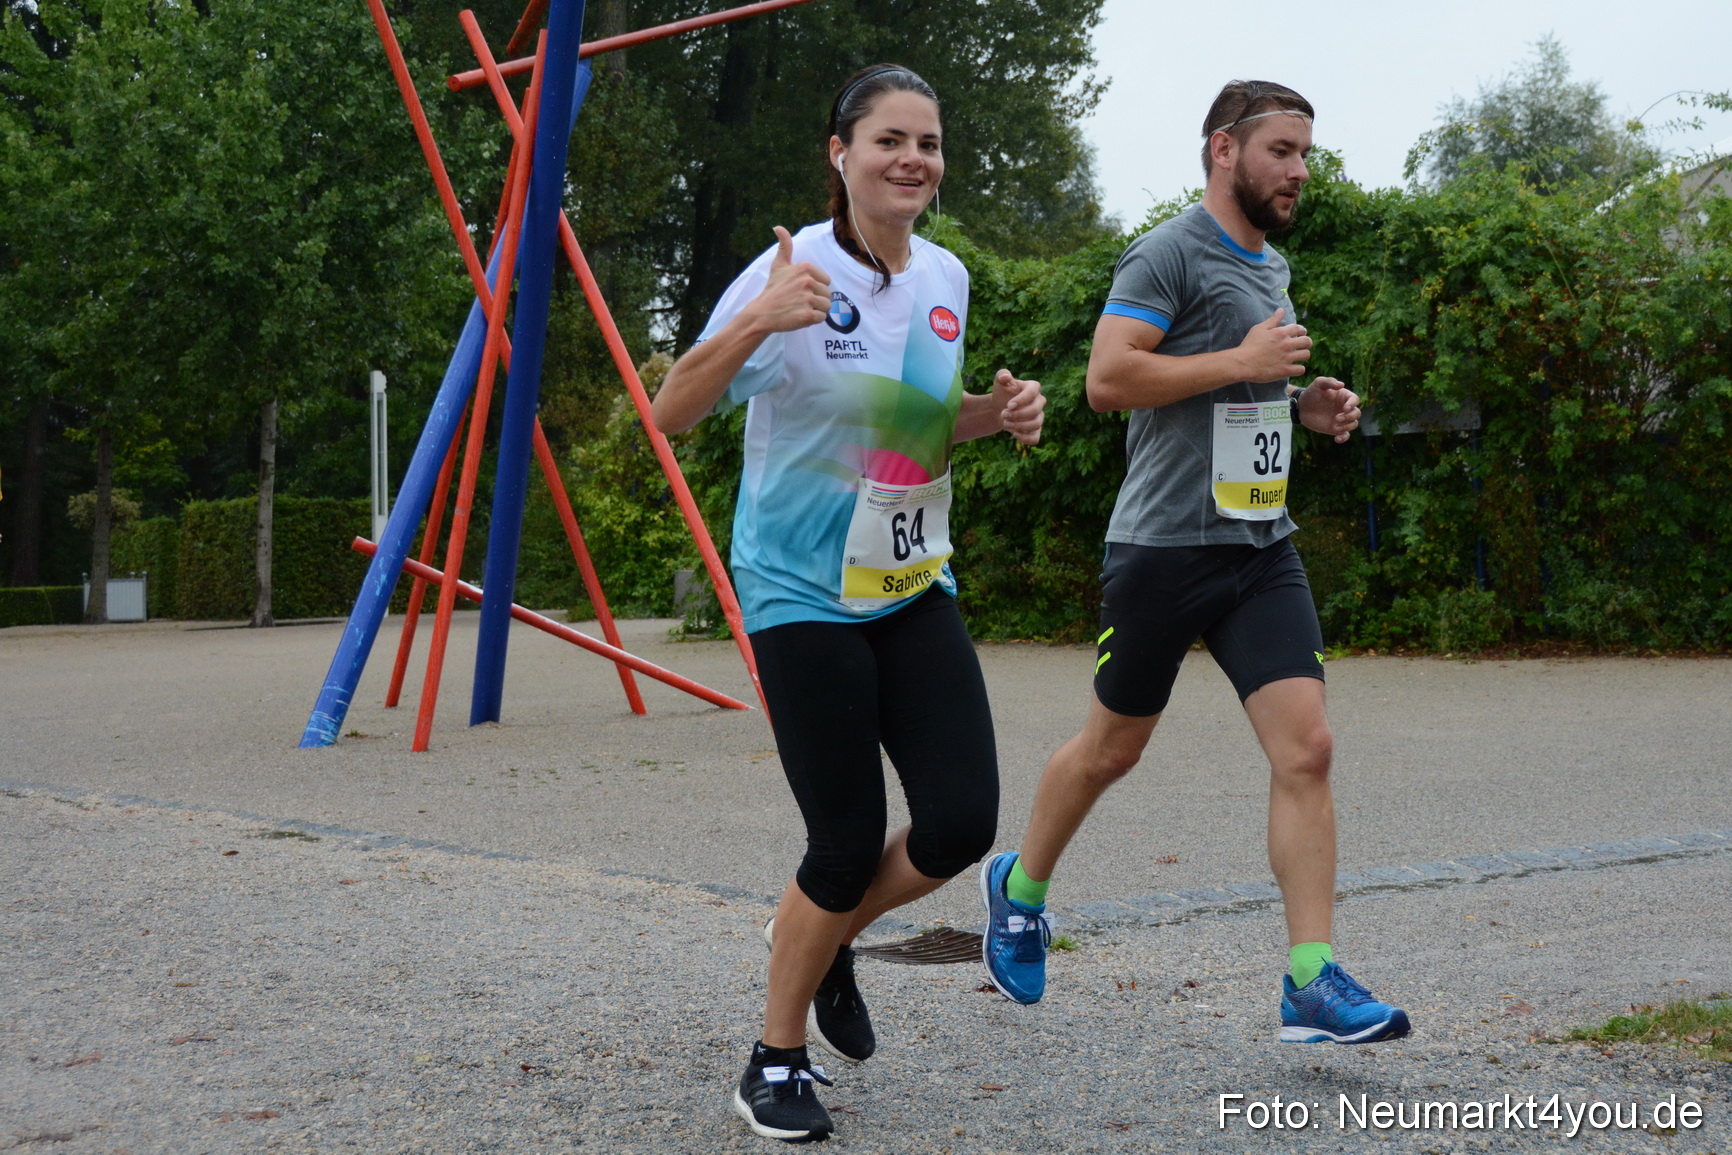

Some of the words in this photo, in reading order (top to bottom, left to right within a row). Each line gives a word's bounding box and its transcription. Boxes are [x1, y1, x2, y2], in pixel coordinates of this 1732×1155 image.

[825, 340, 867, 352] PARTL
[826, 352, 869, 360] Neumarkt
[1253, 431, 1282, 476] 32
[1218, 473, 1224, 481] C
[891, 507, 928, 562] 64
[849, 557, 856, 565] D
[882, 569, 932, 593] Sabine
